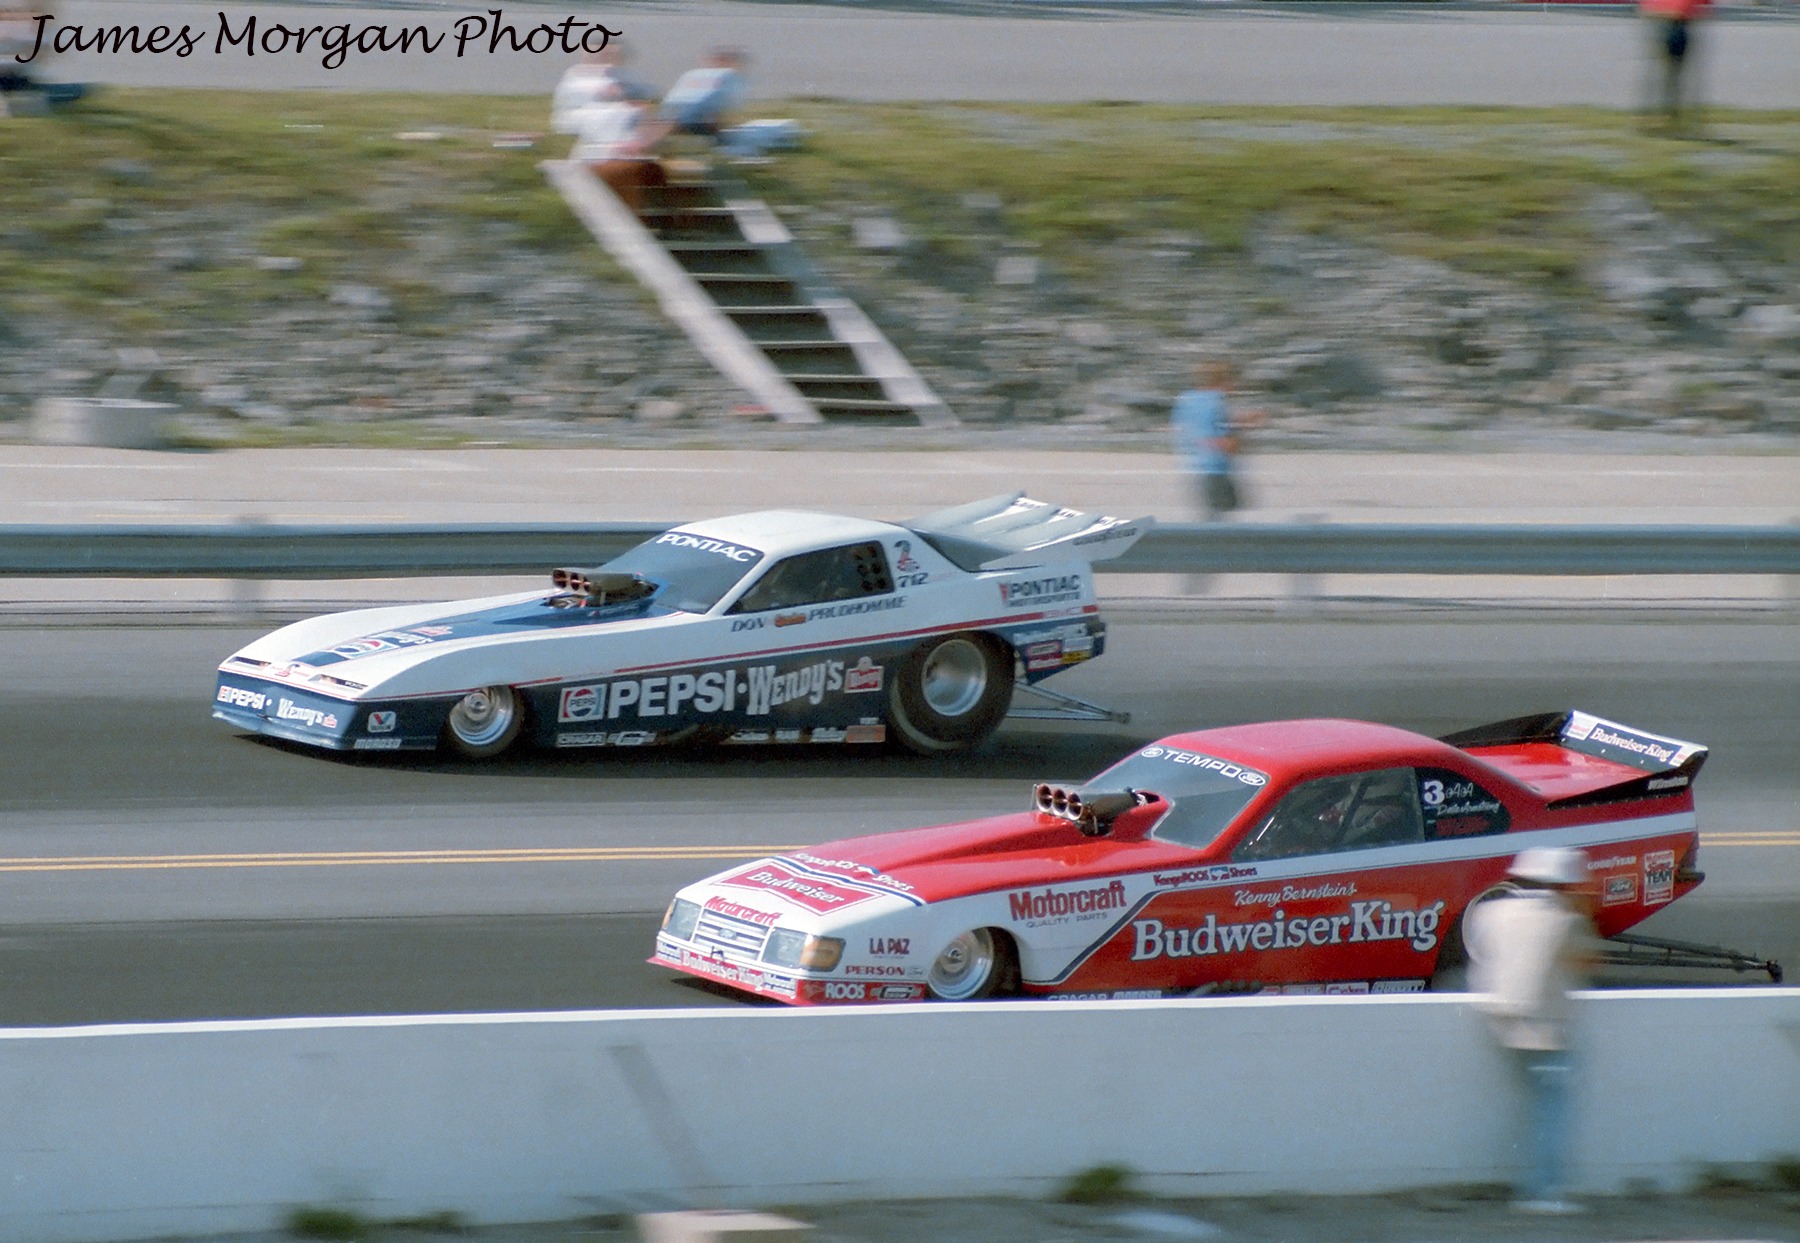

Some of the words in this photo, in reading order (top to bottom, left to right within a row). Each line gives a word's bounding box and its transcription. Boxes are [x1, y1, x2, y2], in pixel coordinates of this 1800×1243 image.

[656, 533, 756, 562] PONTIAC
[898, 572, 928, 588] 712
[1008, 574, 1080, 598] PONTIAC
[731, 618, 766, 633] DON
[607, 669, 737, 720] PEPSI
[746, 659, 844, 716] Wendy's
[228, 687, 267, 710] PEPSI
[276, 697, 325, 727] Wendy's
[1589, 727, 1648, 754] Budweiser
[1645, 743, 1674, 763] King
[1164, 749, 1242, 778] TEMPO
[1423, 780, 1446, 805] 3
[746, 871, 845, 904] Budweiser
[872, 873, 915, 892] Shoes
[704, 895, 783, 926] Motorcraft
[1009, 880, 1127, 922] Motorcraft
[1234, 889, 1281, 908] Kenny
[1026, 915, 1070, 928] QUALITY
[1076, 911, 1108, 922] PARTS
[1131, 908, 1351, 961] Budweiser
[1349, 900, 1446, 951] King
[869, 937, 885, 955] LA
[887, 937, 910, 955] PAZ
[681, 951, 738, 981] Budweiser
[737, 964, 765, 991] King
[845, 965, 905, 976] PERSON
[825, 982, 866, 999] ROOS
